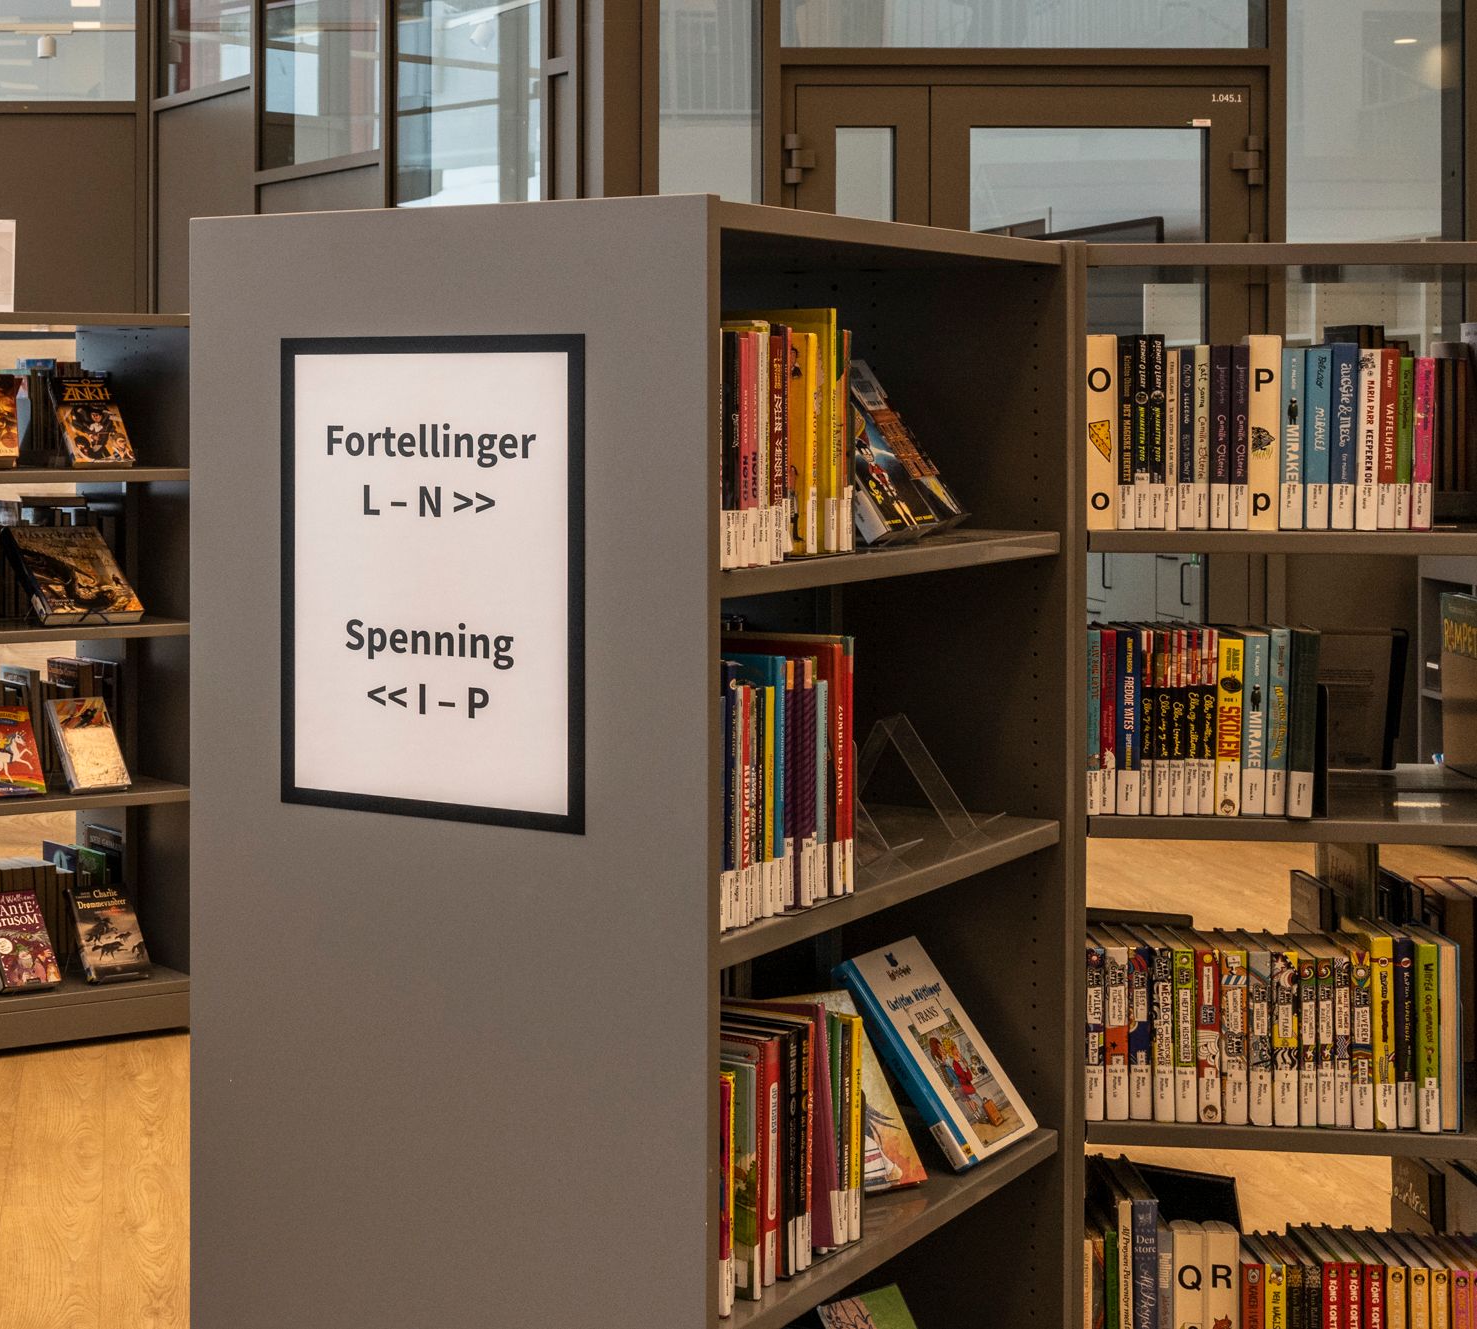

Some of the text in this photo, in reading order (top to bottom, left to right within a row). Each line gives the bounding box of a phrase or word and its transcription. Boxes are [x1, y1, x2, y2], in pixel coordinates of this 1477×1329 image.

[1212, 94, 1242, 103] 1.045.1
[1138, 339, 1147, 364] DERMOT
[1154, 340, 1162, 364] DERMOT
[1088, 367, 1111, 392] O
[1255, 368, 1274, 392] P
[1367, 380, 1375, 400] MARIA
[61, 385, 113, 402] ANKH
[1366, 401, 1374, 425] PARR
[1216, 414, 1226, 442] Camilla
[1236, 414, 1246, 442] Camilla
[1384, 403, 1395, 471] VAFFELHJARTE
[327, 423, 536, 468] Fortellinger
[1285, 425, 1299, 484] MIRAKE
[1365, 429, 1374, 473] KEEPEREN
[364, 484, 381, 516] L
[419, 485, 442, 518] N
[1252, 492, 1271, 516] p
[345, 619, 514, 670] Spenning
[1231, 648, 1240, 672] JAMES
[419, 684, 426, 715] I
[468, 687, 490, 719] P
[1124, 676, 1135, 704] FREDDIE
[1248, 711, 1263, 769] MIRAKE
[92, 888, 118, 900] Charlie
[914, 1005, 940, 1026] FRANS
[1093, 989, 1101, 1021] HVILKET
[1161, 984, 1171, 1026] MEGABOK
[1181, 996, 1191, 1061] HEFTIGE HISTORIER
[1361, 1008, 1369, 1043] SUVEREN
[1134, 1245, 1157, 1254] store
[1136, 1235, 1155, 1244] Den
[1178, 1265, 1201, 1292] Q
[1211, 1264, 1232, 1290] R
[1122, 1280, 1130, 1308] eventyr
